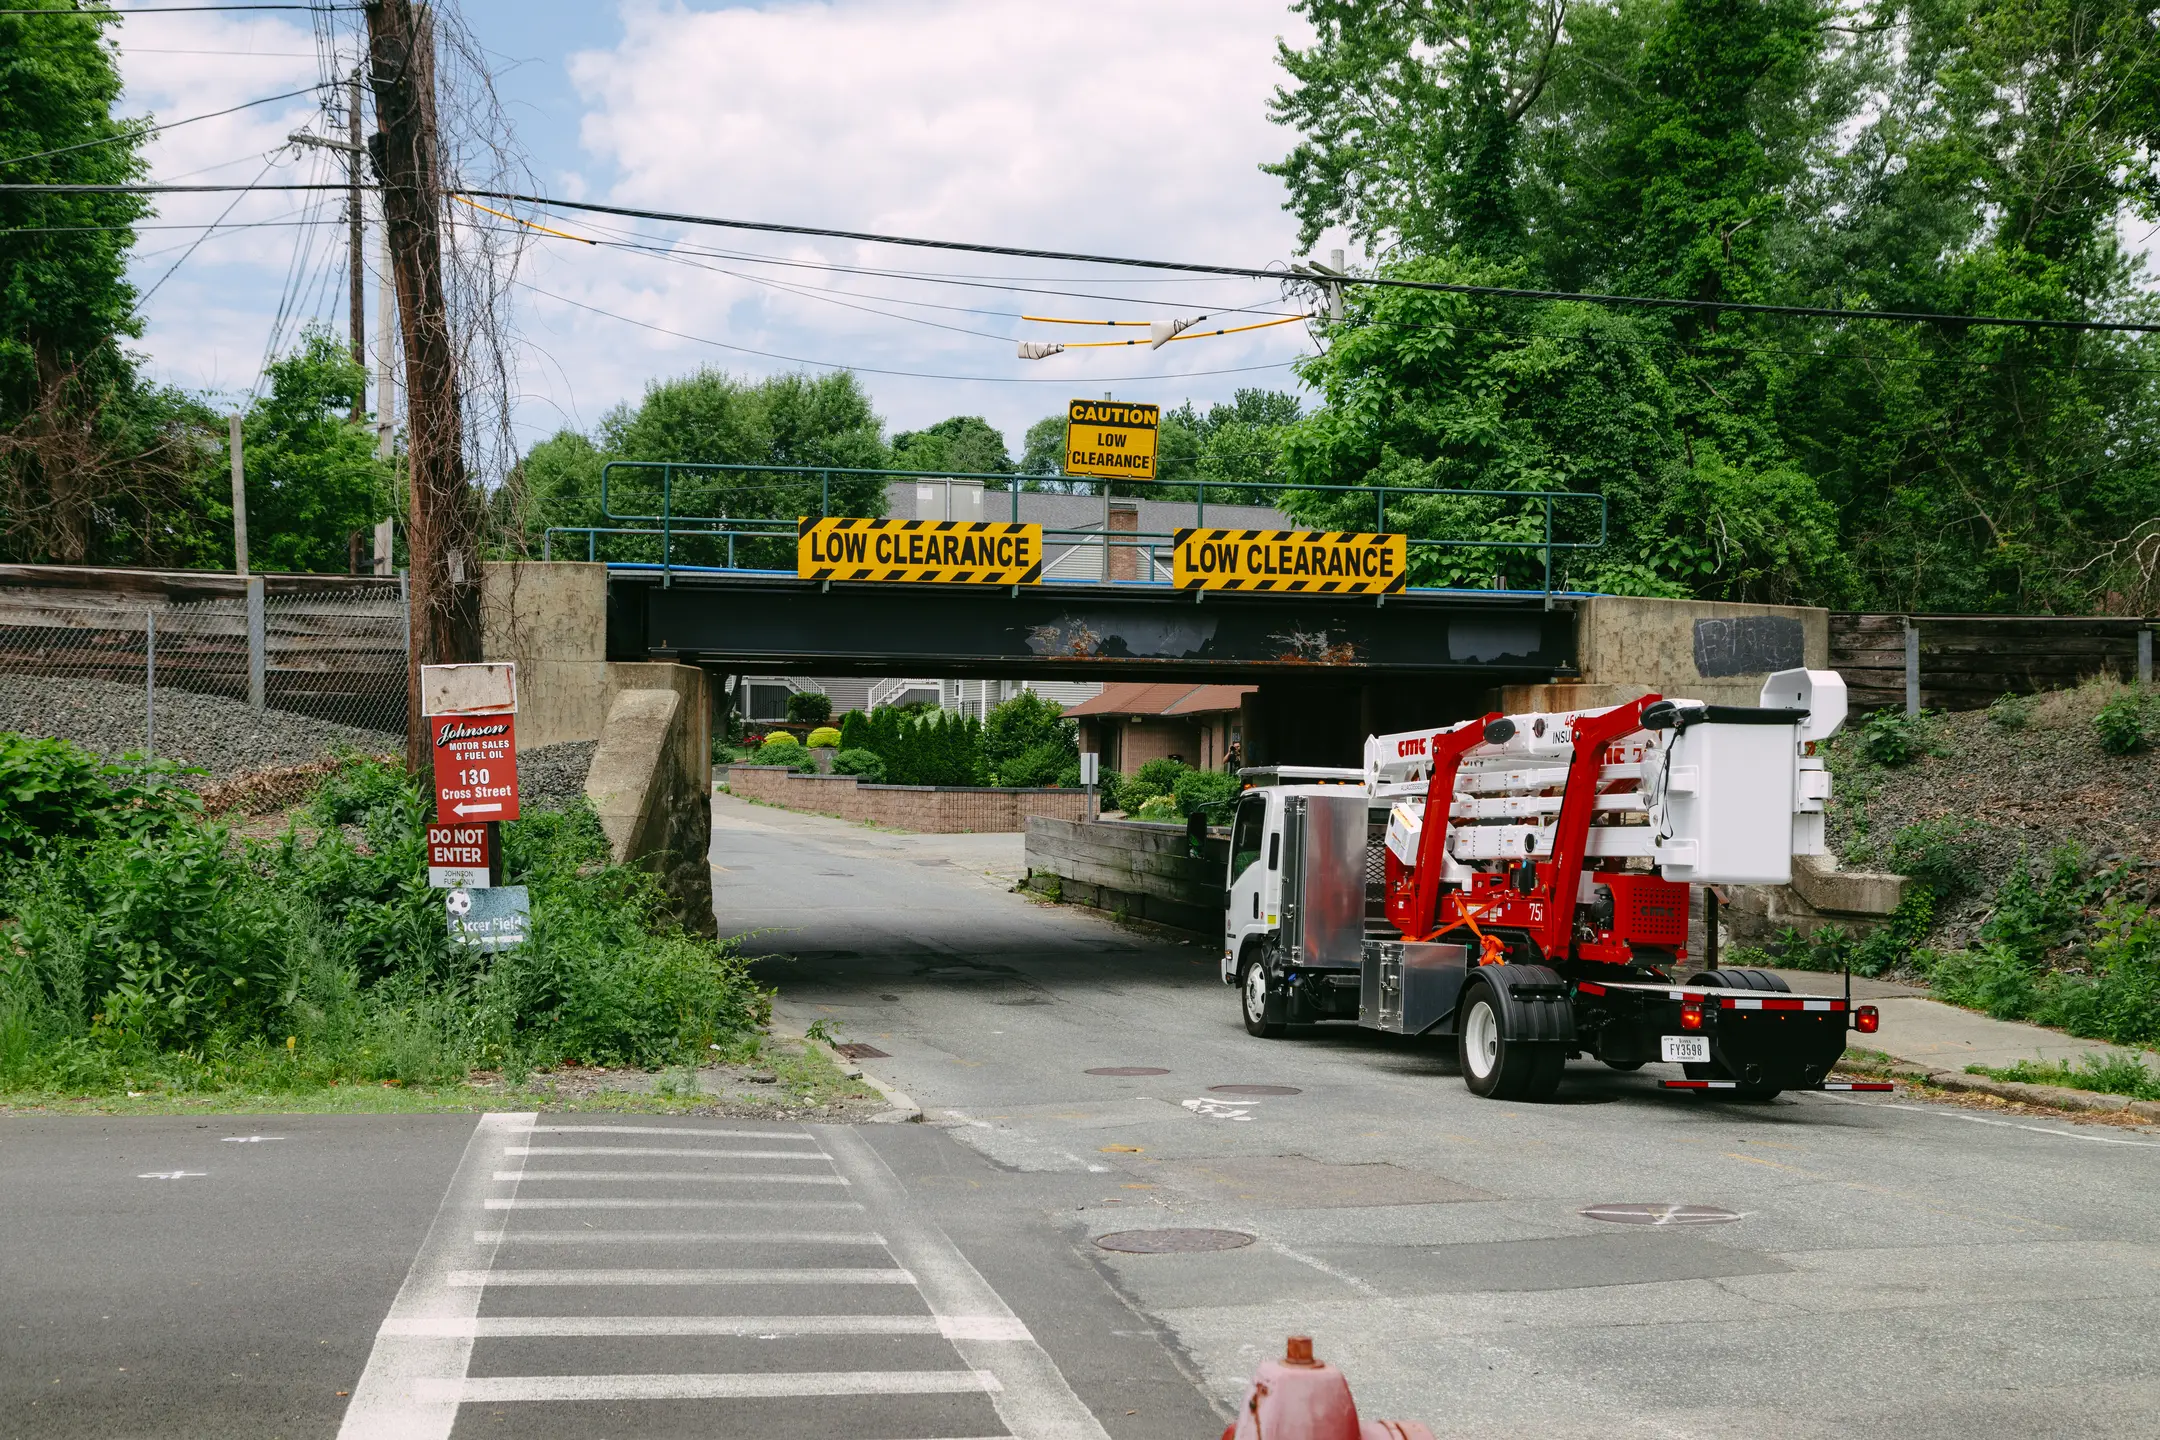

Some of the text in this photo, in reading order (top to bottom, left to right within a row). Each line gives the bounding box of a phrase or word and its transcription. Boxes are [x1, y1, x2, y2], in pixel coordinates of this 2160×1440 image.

[1071, 405, 1157, 425] CAUTION
[1097, 433, 1127, 448] LOW
[1072, 451, 1150, 469] CLEARANCE
[811, 532, 1030, 568] LOW CLEARANCE
[1185, 543, 1394, 578] LOW CLEARANCE
[436, 723, 508, 747] Johnson
[449, 740, 509, 751] MOTOR SALES
[456, 752, 462, 761] &
[465, 752, 486, 760] FUEL
[459, 769, 490, 785] 130
[442, 785, 511, 800] Cross Street
[430, 829, 484, 844] DO NOT
[434, 847, 481, 862] ENTER
[1528, 902, 1544, 922] 75i
[493, 916, 522, 930] Field
[1670, 1043, 1703, 1057] FY3598
